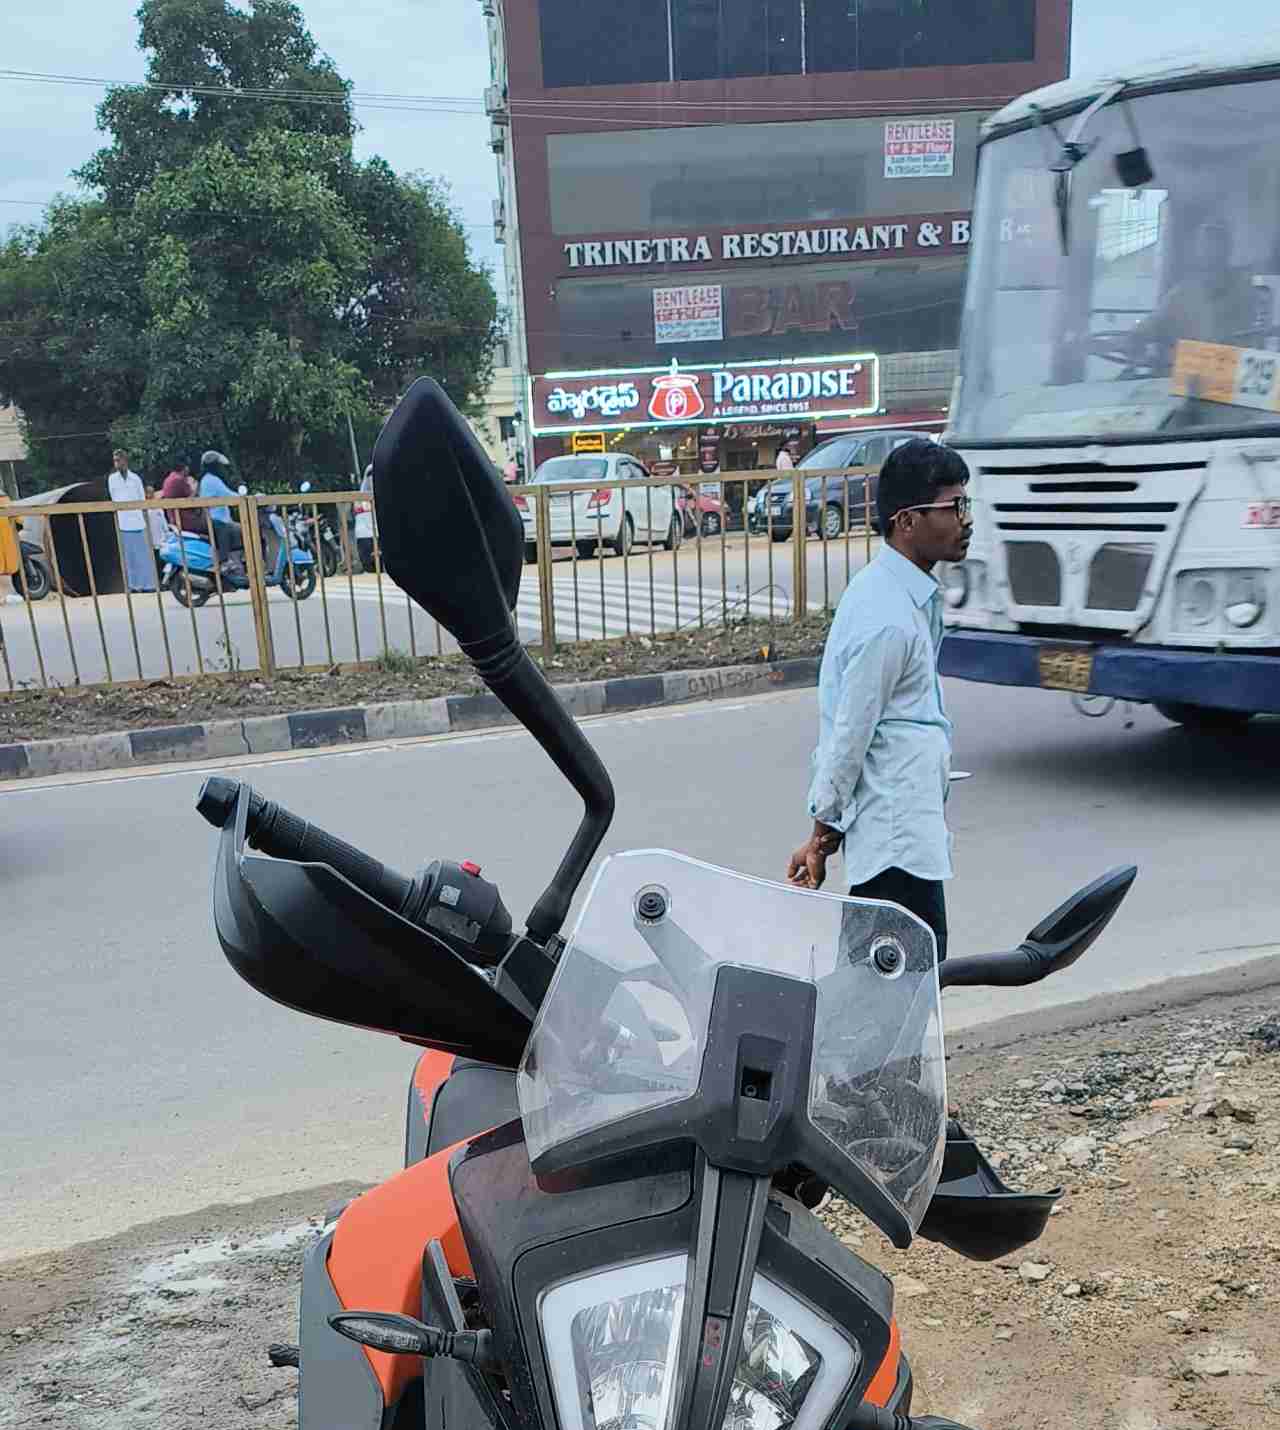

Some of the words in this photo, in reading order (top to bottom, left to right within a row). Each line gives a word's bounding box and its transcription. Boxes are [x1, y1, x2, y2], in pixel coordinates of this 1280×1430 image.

[564, 236, 712, 267] TRINETRA
[722, 224, 909, 259] RESTAURANT
[917, 222, 942, 246] &
[728, 281, 859, 336] BAR
